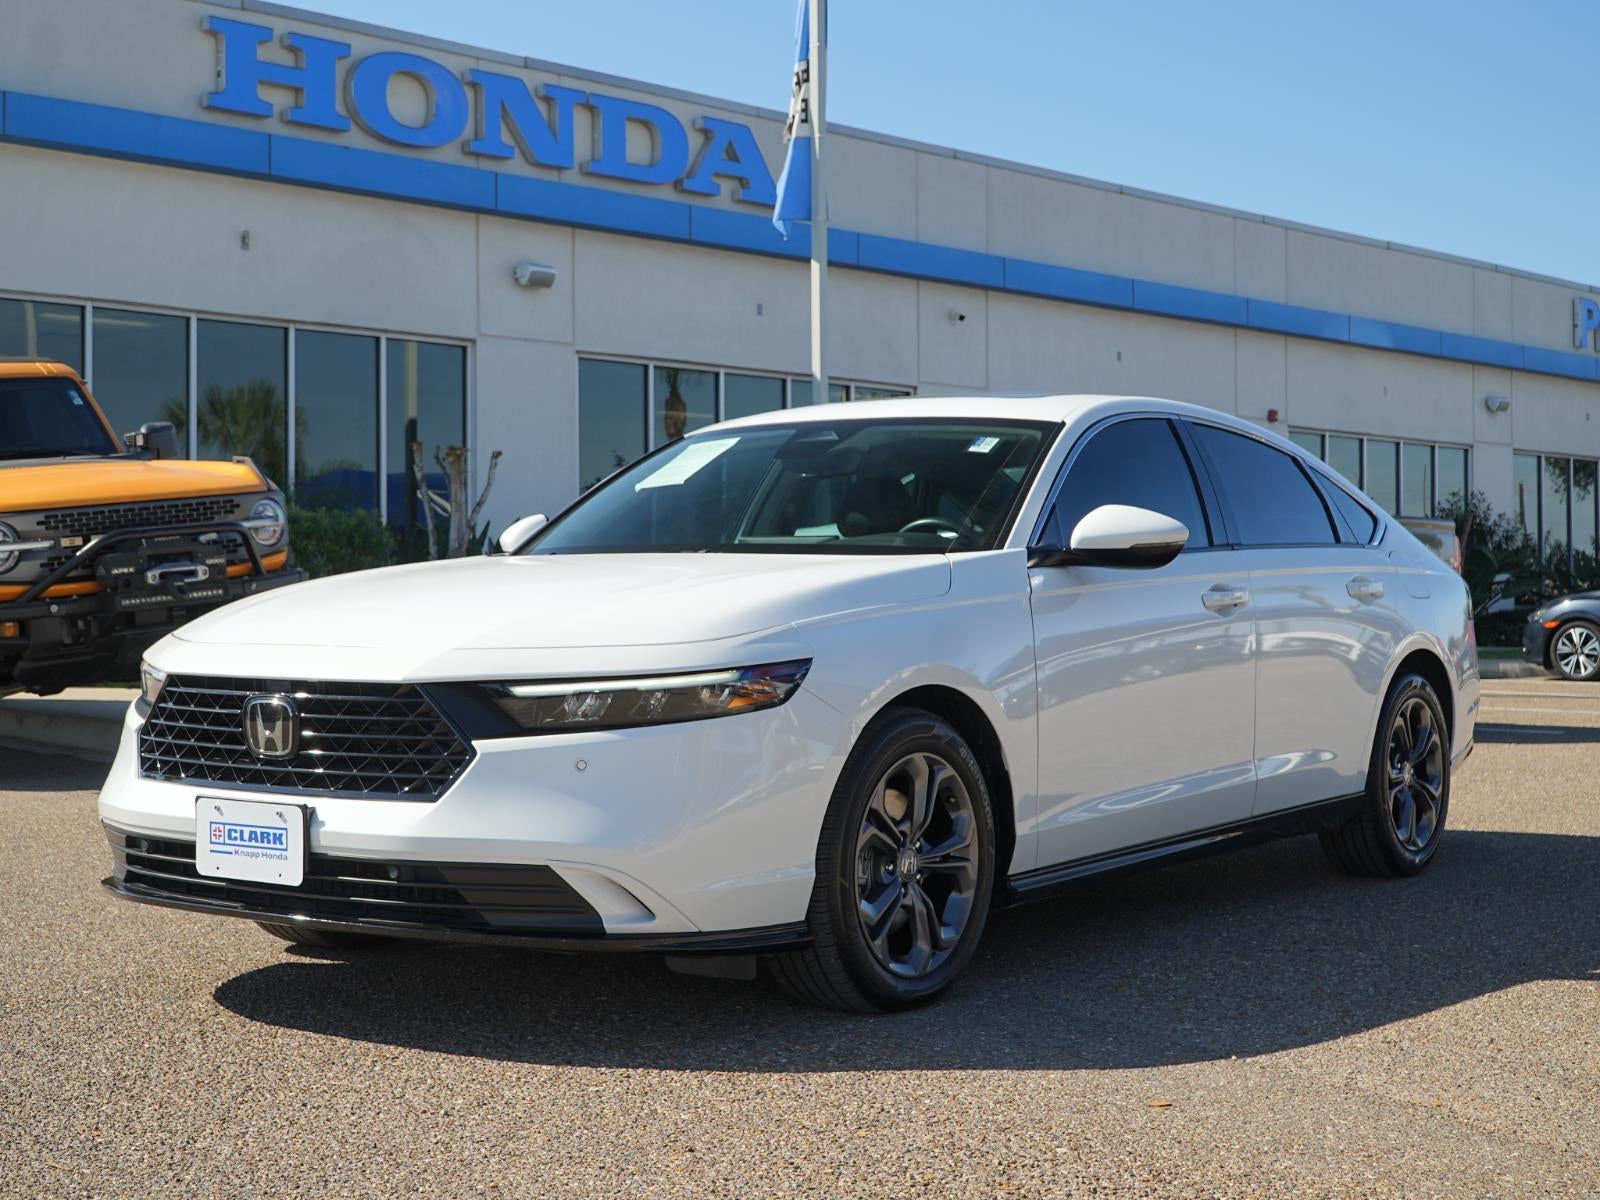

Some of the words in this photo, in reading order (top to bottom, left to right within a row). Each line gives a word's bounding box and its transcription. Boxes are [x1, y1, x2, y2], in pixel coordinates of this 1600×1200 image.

[203, 16, 778, 207] HONDA
[1573, 296, 1600, 351] P
[227, 828, 284, 846] CLARK
[234, 849, 260, 859] Knapp
[261, 851, 288, 861] Honda
